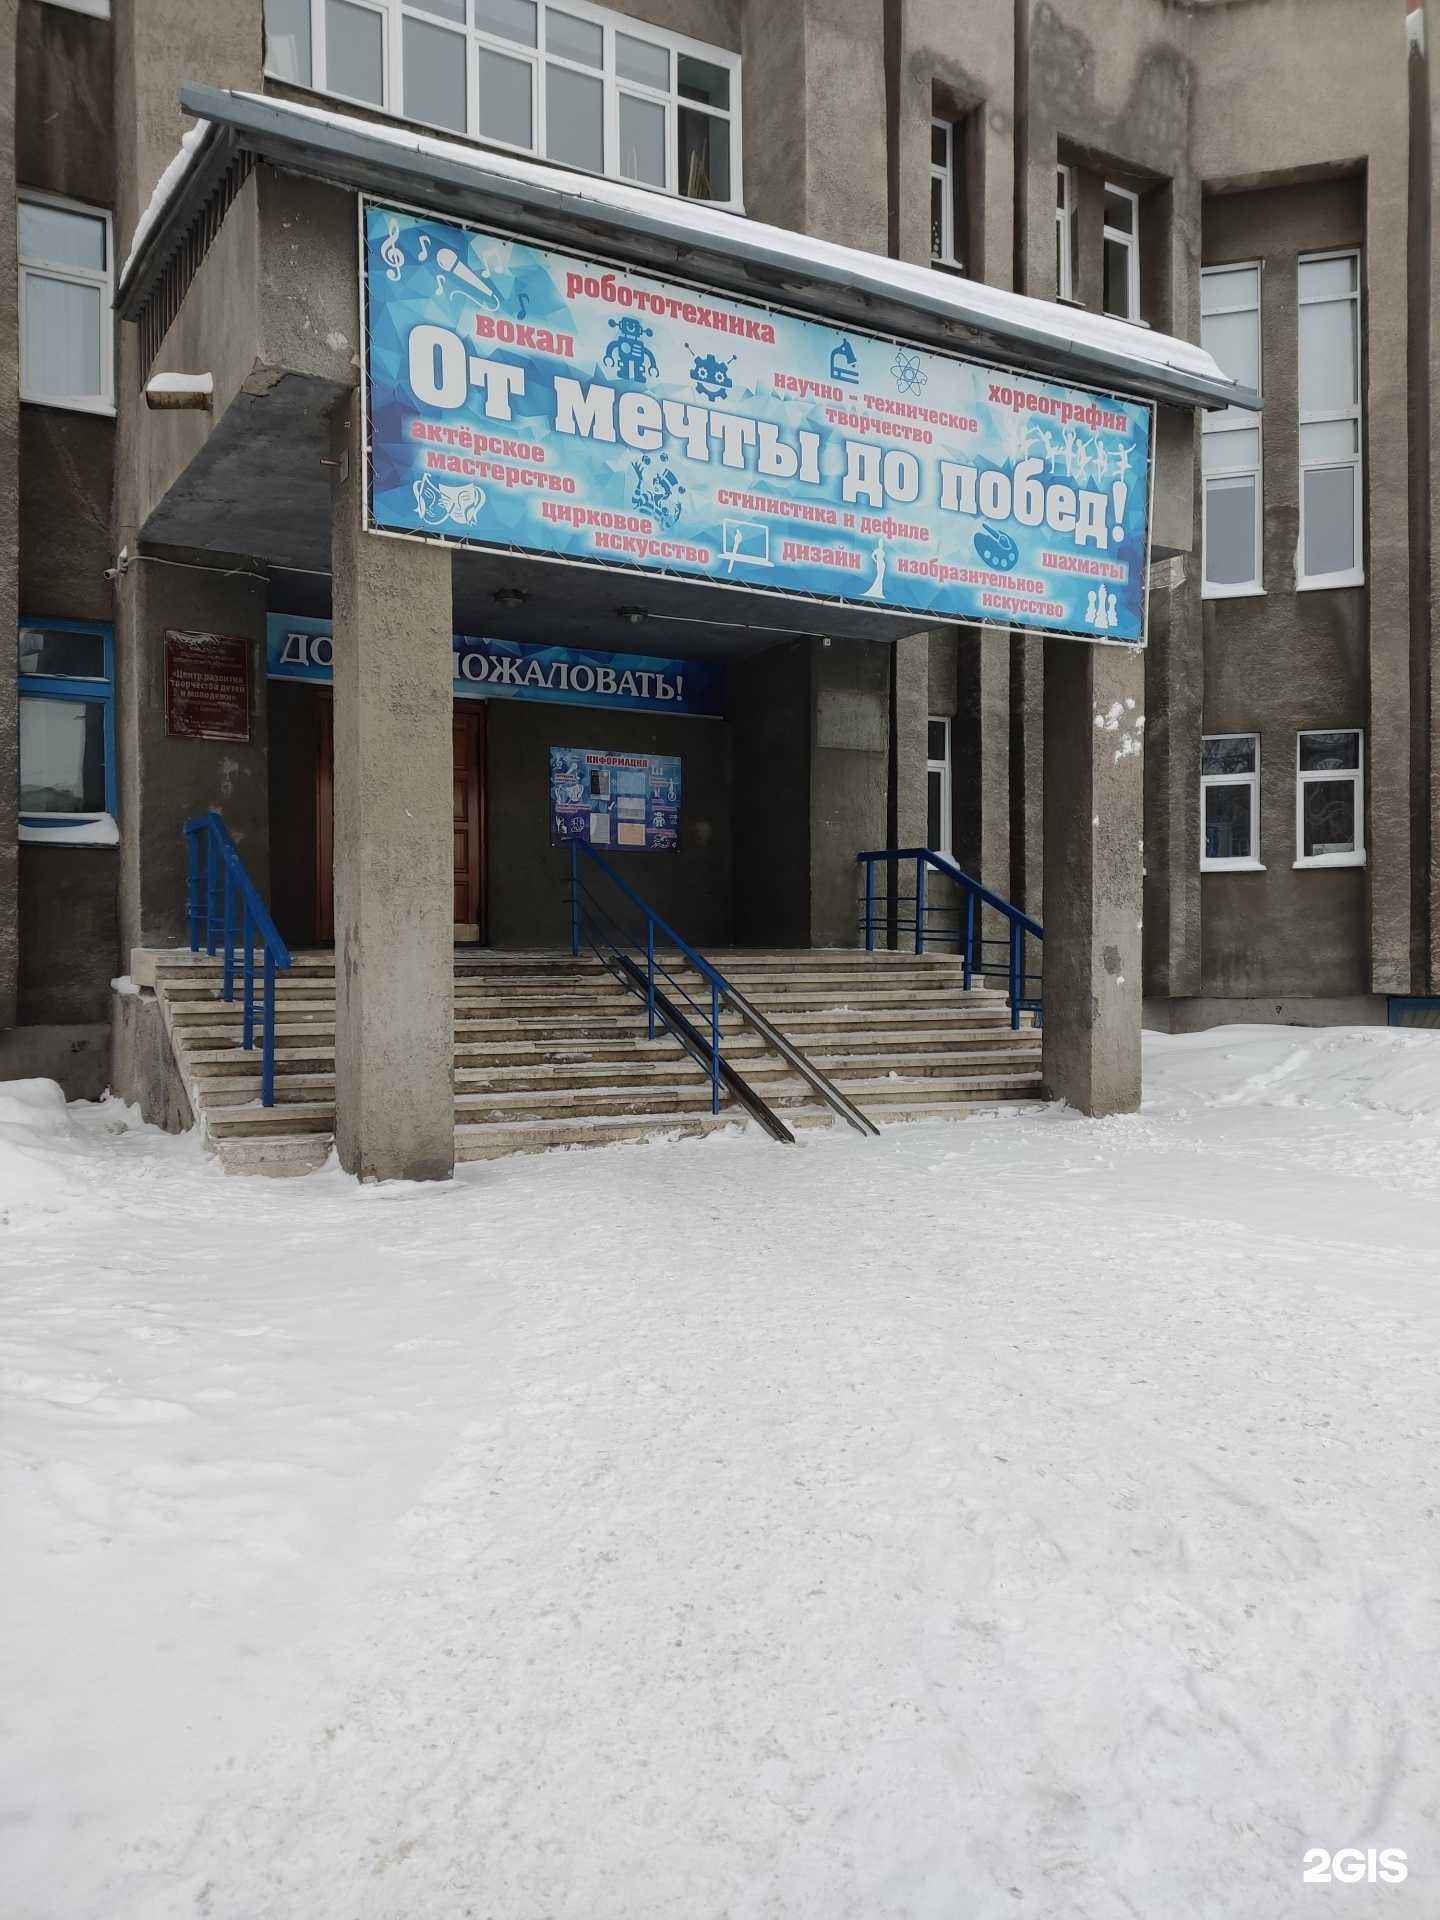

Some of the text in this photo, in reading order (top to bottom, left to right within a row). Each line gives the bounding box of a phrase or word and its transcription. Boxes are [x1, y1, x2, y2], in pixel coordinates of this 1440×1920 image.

[566, 272, 775, 344] робототехника
[475, 315, 574, 358] вокал
[774, 373, 843, 402] научно
[863, 393, 978, 433] техническое
[988, 384, 1127, 432] хореография
[408, 324, 1128, 549] От мечты до побед!
[411, 421, 545, 463] актёрское
[825, 408, 933, 445] творчество
[427, 451, 575, 494] мастерство
[542, 502, 653, 535] цирковое
[718, 488, 929, 542] стилистика и дефиле
[595, 531, 710, 564] искусство
[783, 542, 861, 570] дизайн
[1042, 552, 1124, 580] шахматы
[898, 557, 1044, 594] изобразительное
[982, 592, 1064, 619] искусство
